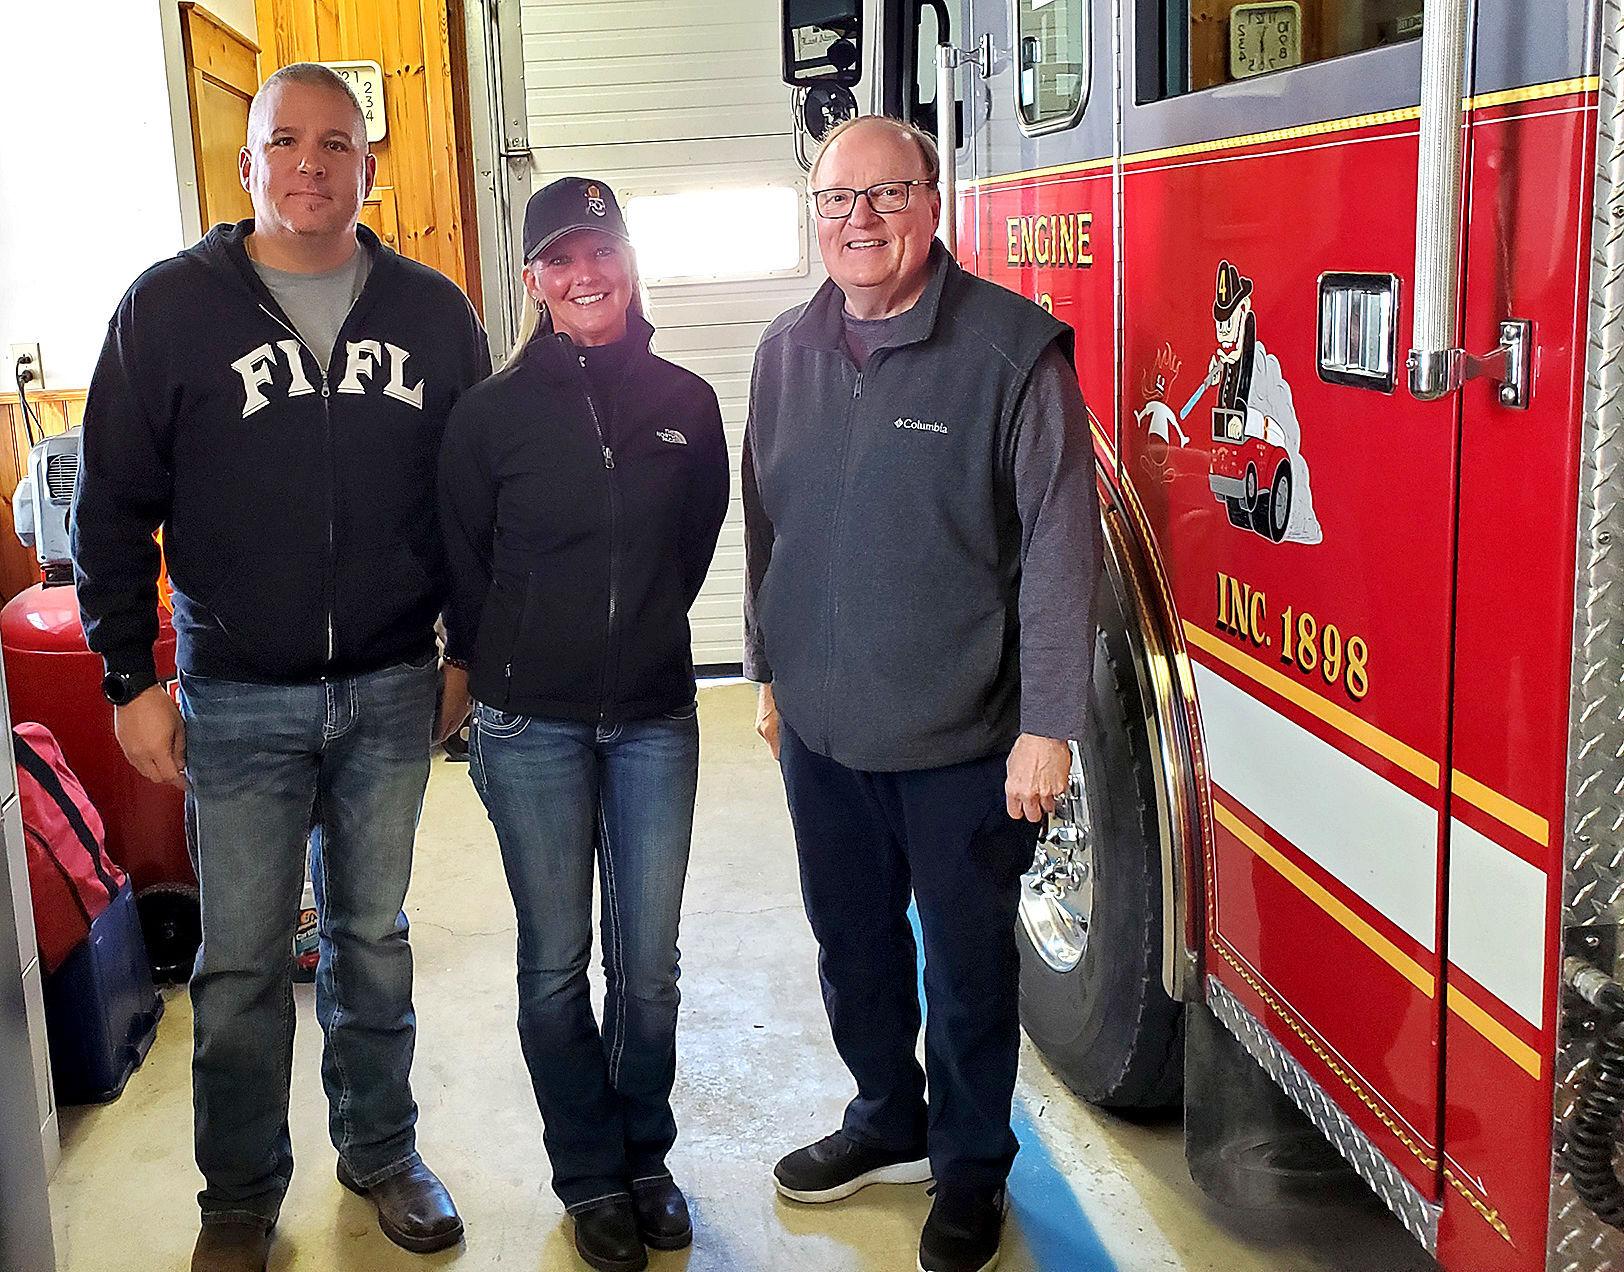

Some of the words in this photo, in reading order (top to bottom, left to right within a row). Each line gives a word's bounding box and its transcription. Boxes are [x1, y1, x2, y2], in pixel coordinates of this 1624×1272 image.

[363, 81, 373, 94] 2
[365, 95, 374, 108] 3
[365, 109, 374, 122] 4
[1006, 212, 1094, 268] ENGINE
[1218, 269, 1227, 302] 4
[903, 418, 948, 434] Columbia
[1216, 571, 1271, 646] INC.
[1281, 605, 1369, 700] 1898
